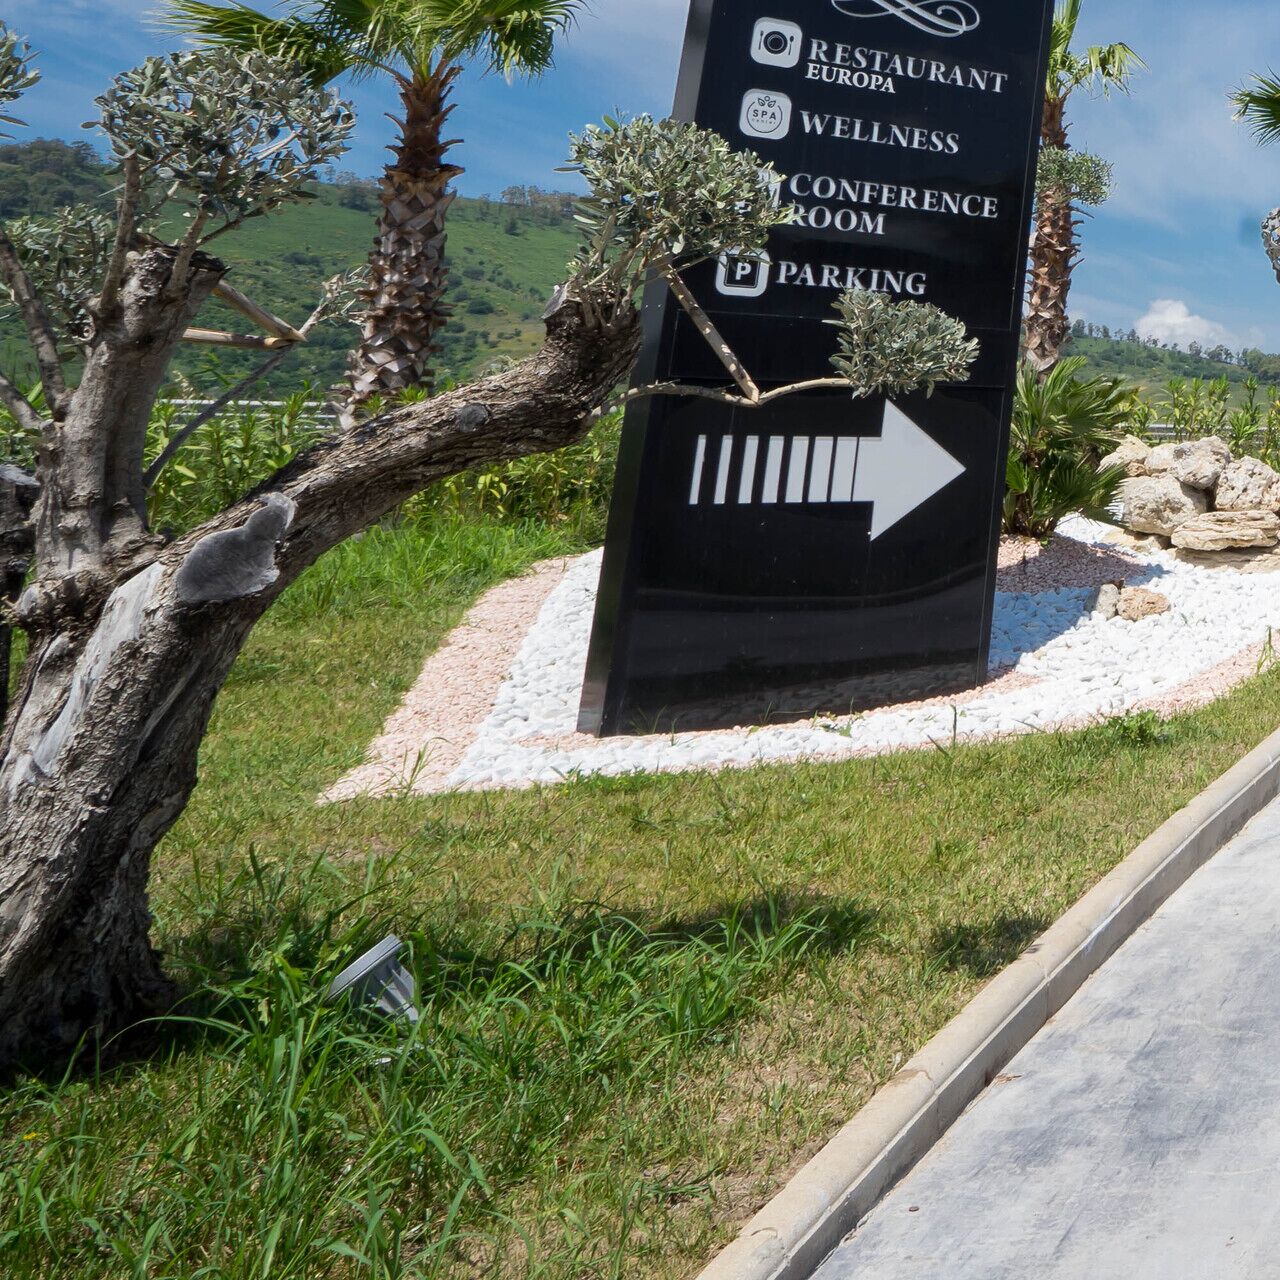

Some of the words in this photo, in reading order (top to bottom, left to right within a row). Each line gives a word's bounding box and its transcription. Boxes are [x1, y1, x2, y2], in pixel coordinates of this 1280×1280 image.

[805, 63, 896, 93] EUROPA
[808, 38, 1008, 93] RESTAURANT
[753, 109, 776, 120] SPA
[800, 110, 960, 154] WELLNESS
[789, 173, 998, 219] CONFERENCE
[787, 203, 887, 235] ROOM
[735, 262, 751, 280] P
[776, 260, 927, 295] PARKING
